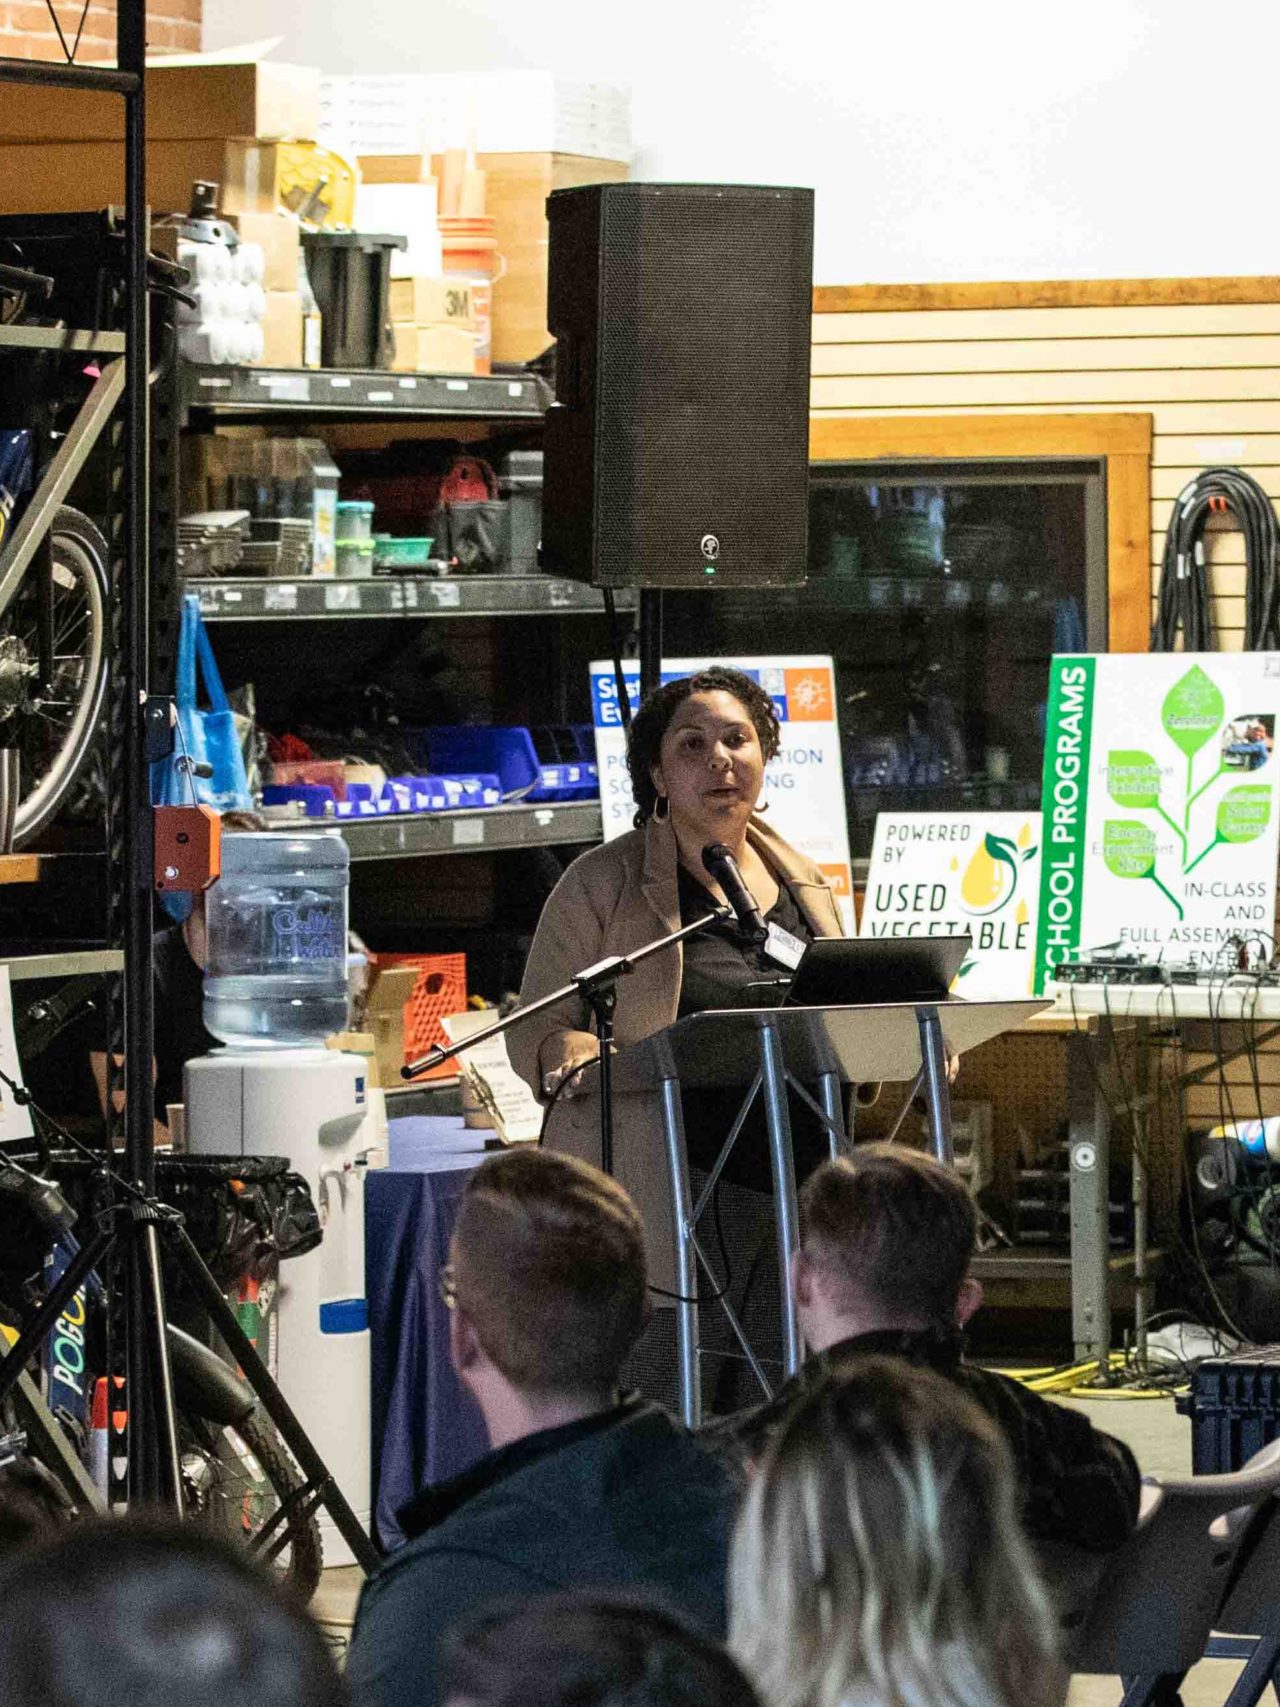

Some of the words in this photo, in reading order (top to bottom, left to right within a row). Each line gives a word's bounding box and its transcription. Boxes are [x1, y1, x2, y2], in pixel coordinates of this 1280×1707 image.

[446, 288, 469, 318] 3M
[1052, 666, 1088, 843] PROGRAMS
[886, 824, 971, 842] POWERED
[883, 846, 906, 863] BY
[875, 883, 947, 912] USED
[1184, 881, 1267, 898] IN-CLASS
[1224, 905, 1266, 920] AND
[1120, 928, 1161, 943] FULL
[53, 1284, 86, 1395] POGO
